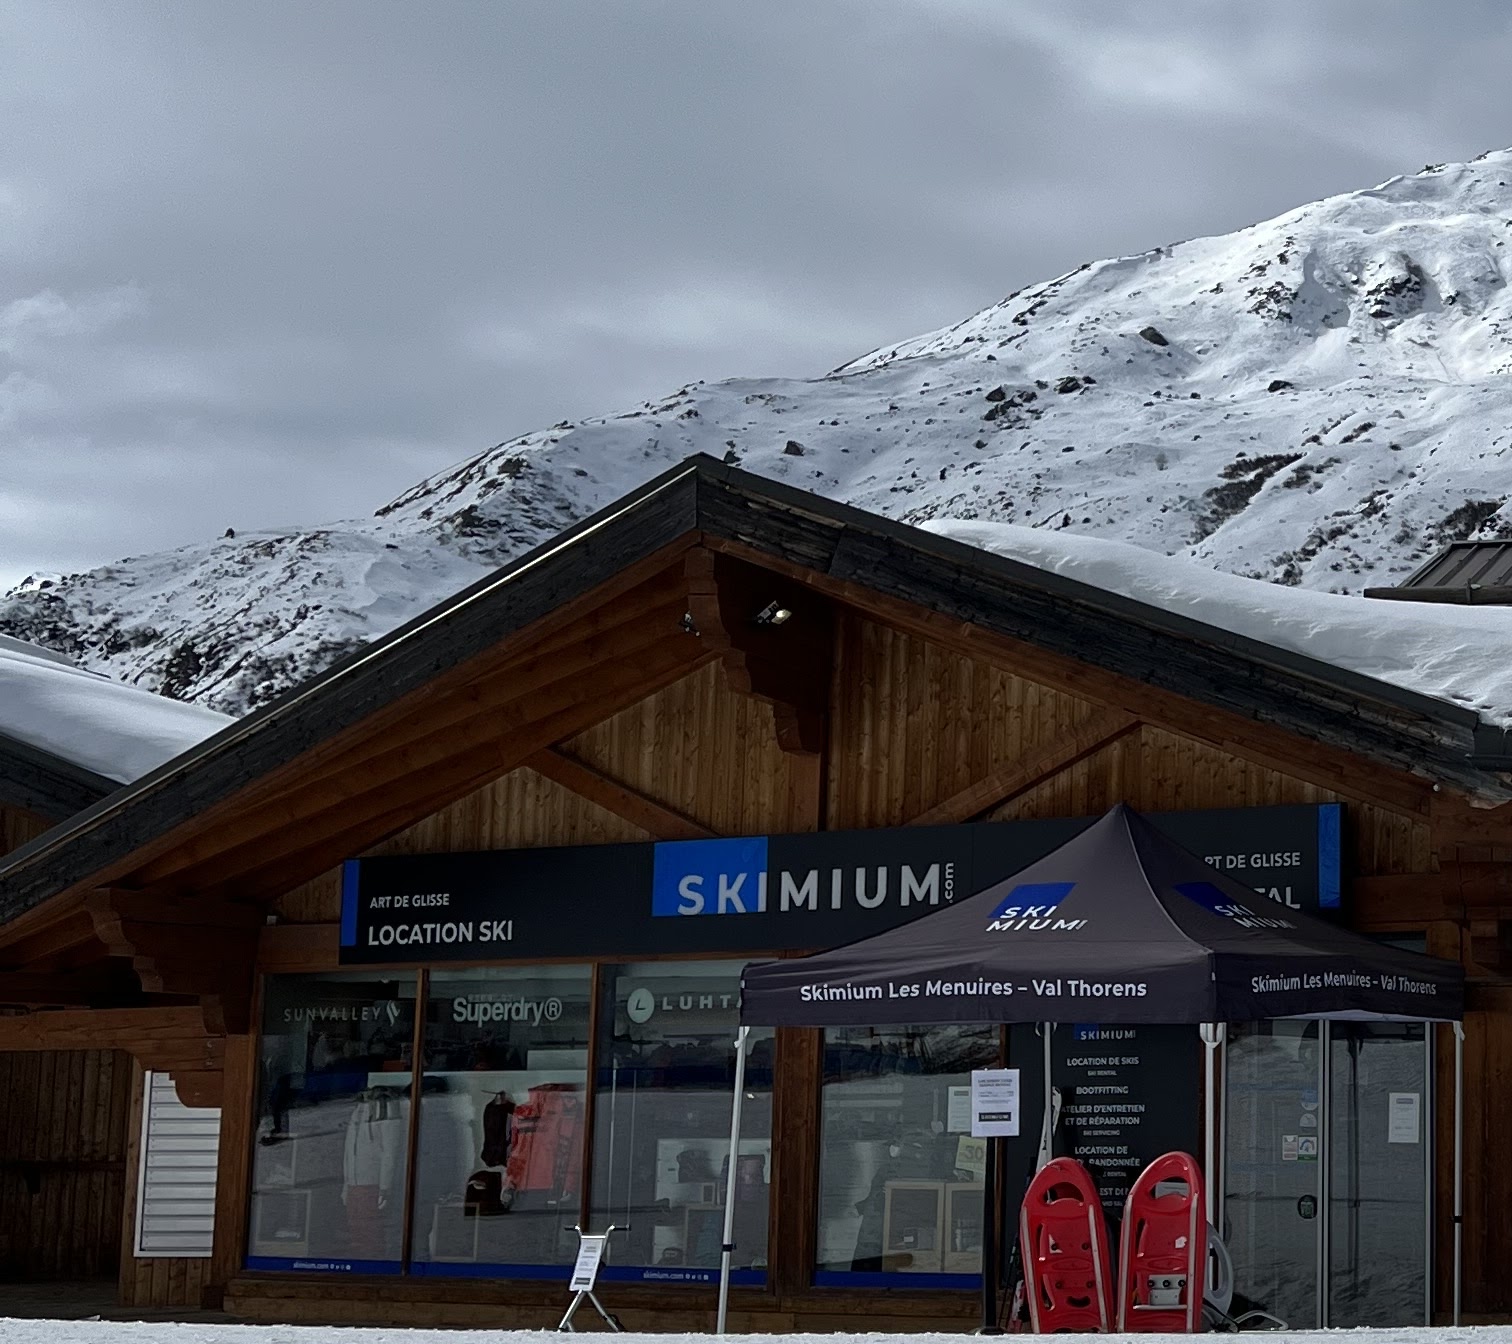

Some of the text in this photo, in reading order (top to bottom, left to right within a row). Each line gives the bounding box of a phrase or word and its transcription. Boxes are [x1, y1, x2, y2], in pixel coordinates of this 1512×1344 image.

[1226, 855, 1246, 869] DE
[1250, 852, 1301, 868] GLISSE
[677, 863, 941, 916] SKIMIUM
[369, 893, 450, 909] ART DE GLISSE
[1000, 905, 1057, 919] SKI
[368, 920, 513, 946] LOCATION SKI
[800, 984, 882, 1001] Skimium
[889, 982, 920, 998] Les
[926, 977, 1012, 996] Menuires
[1032, 979, 1061, 996] Val
[1067, 980, 1147, 997] Thorens
[1252, 974, 1300, 993] Skimium
[1304, 973, 1322, 989] Les
[1324, 970, 1371, 988] Menuires
[1381, 975, 1396, 990] Val
[1398, 977, 1437, 995] Thorens
[283, 1007, 380, 1023] SUNVALLEY
[1080, 1030, 1133, 1040] SKIMIUM
[1067, 1057, 1139, 1066] LOCATION DE SKIS
[1076, 1086, 1129, 1095] BOOTFITTING
[1094, 1104, 1145, 1113] D'ENTRETIEN
[1065, 1116, 1140, 1125] ET DE RÉPARATION
[1075, 1146, 1128, 1155] LOCATION DE
